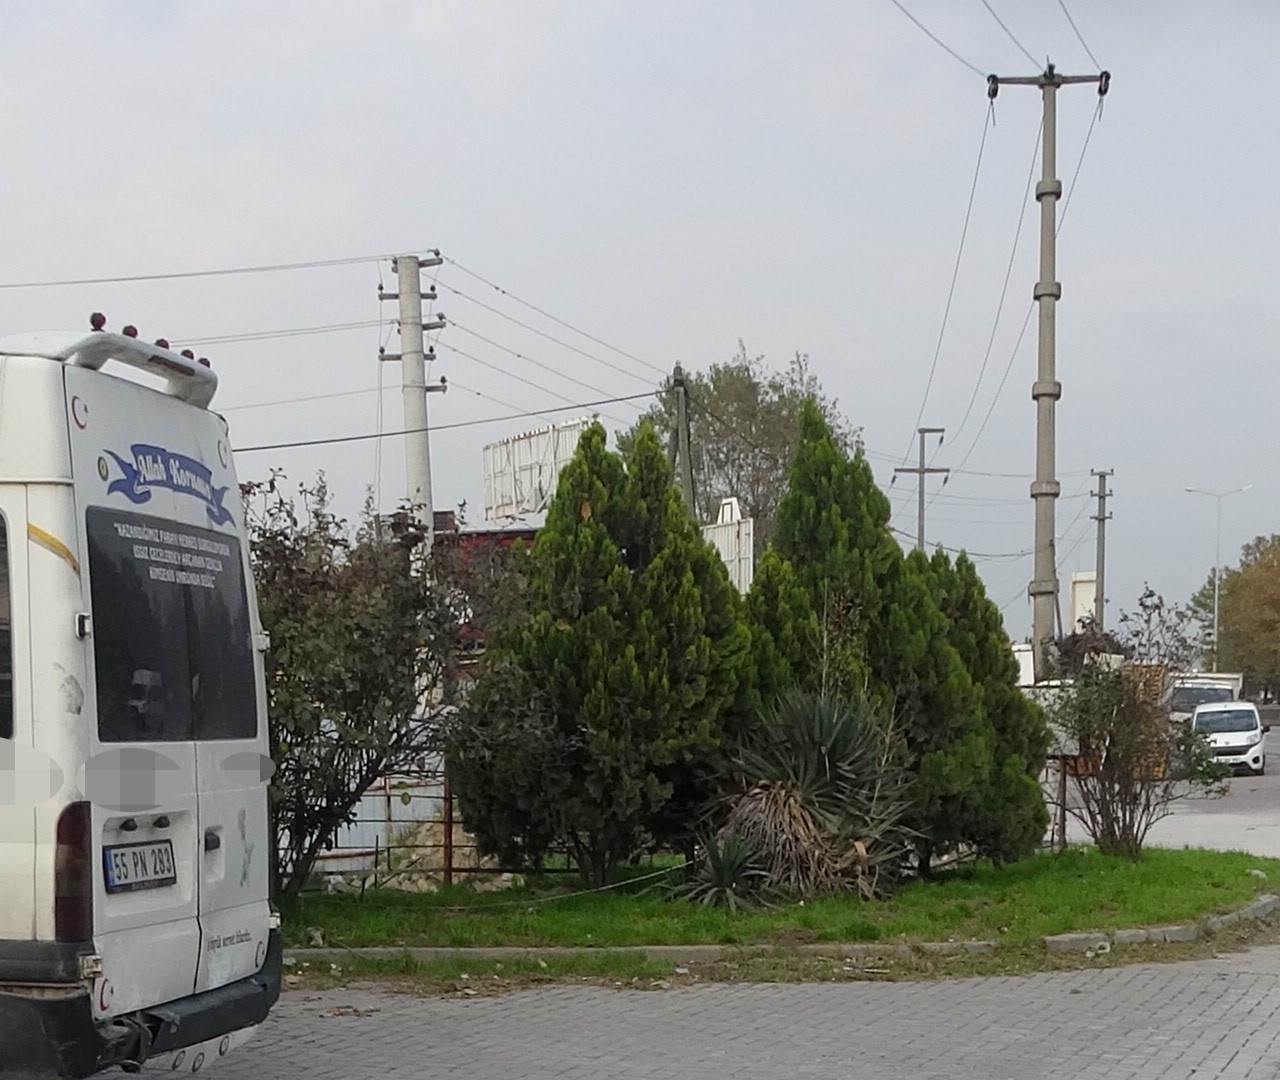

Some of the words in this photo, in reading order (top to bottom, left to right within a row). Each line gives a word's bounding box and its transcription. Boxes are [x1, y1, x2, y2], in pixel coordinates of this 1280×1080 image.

[138, 455, 166, 483] Allah
[113, 852, 128, 881] 55
[132, 850, 148, 879] PN
[151, 848, 172, 876] 283
